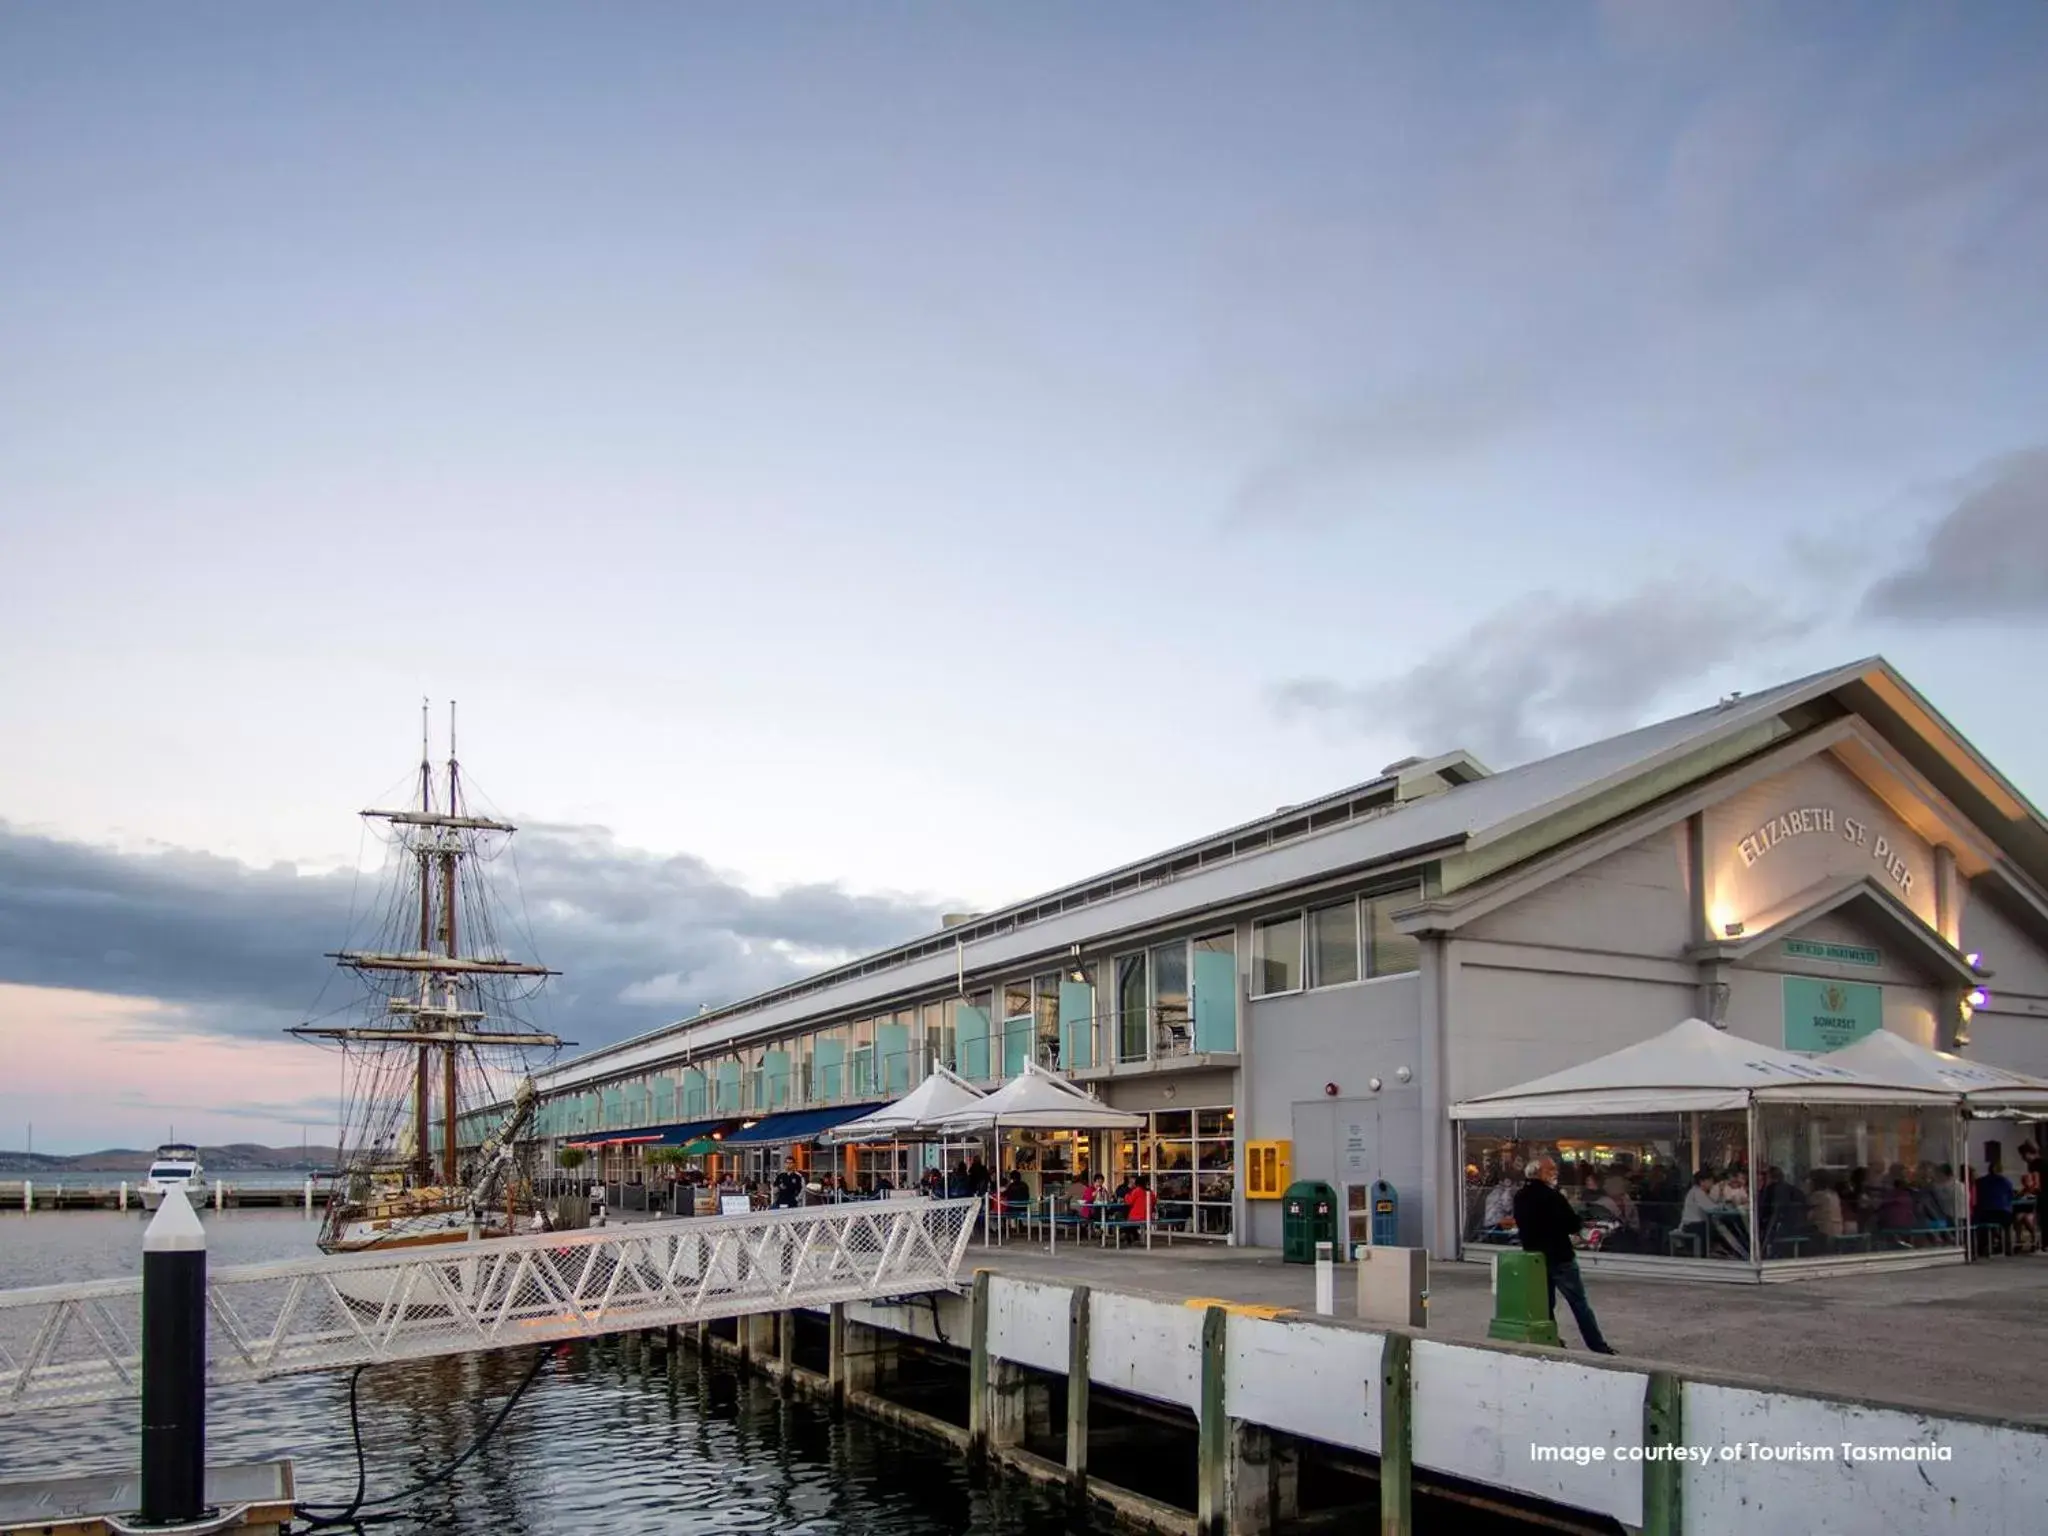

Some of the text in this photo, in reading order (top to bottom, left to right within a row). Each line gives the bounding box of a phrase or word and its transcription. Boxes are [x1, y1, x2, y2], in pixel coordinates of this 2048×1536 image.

[1737, 808, 1835, 868] ELIZABETH
[1873, 836, 1915, 897] PIER
[1812, 1015, 1857, 1031] SOMERSET
